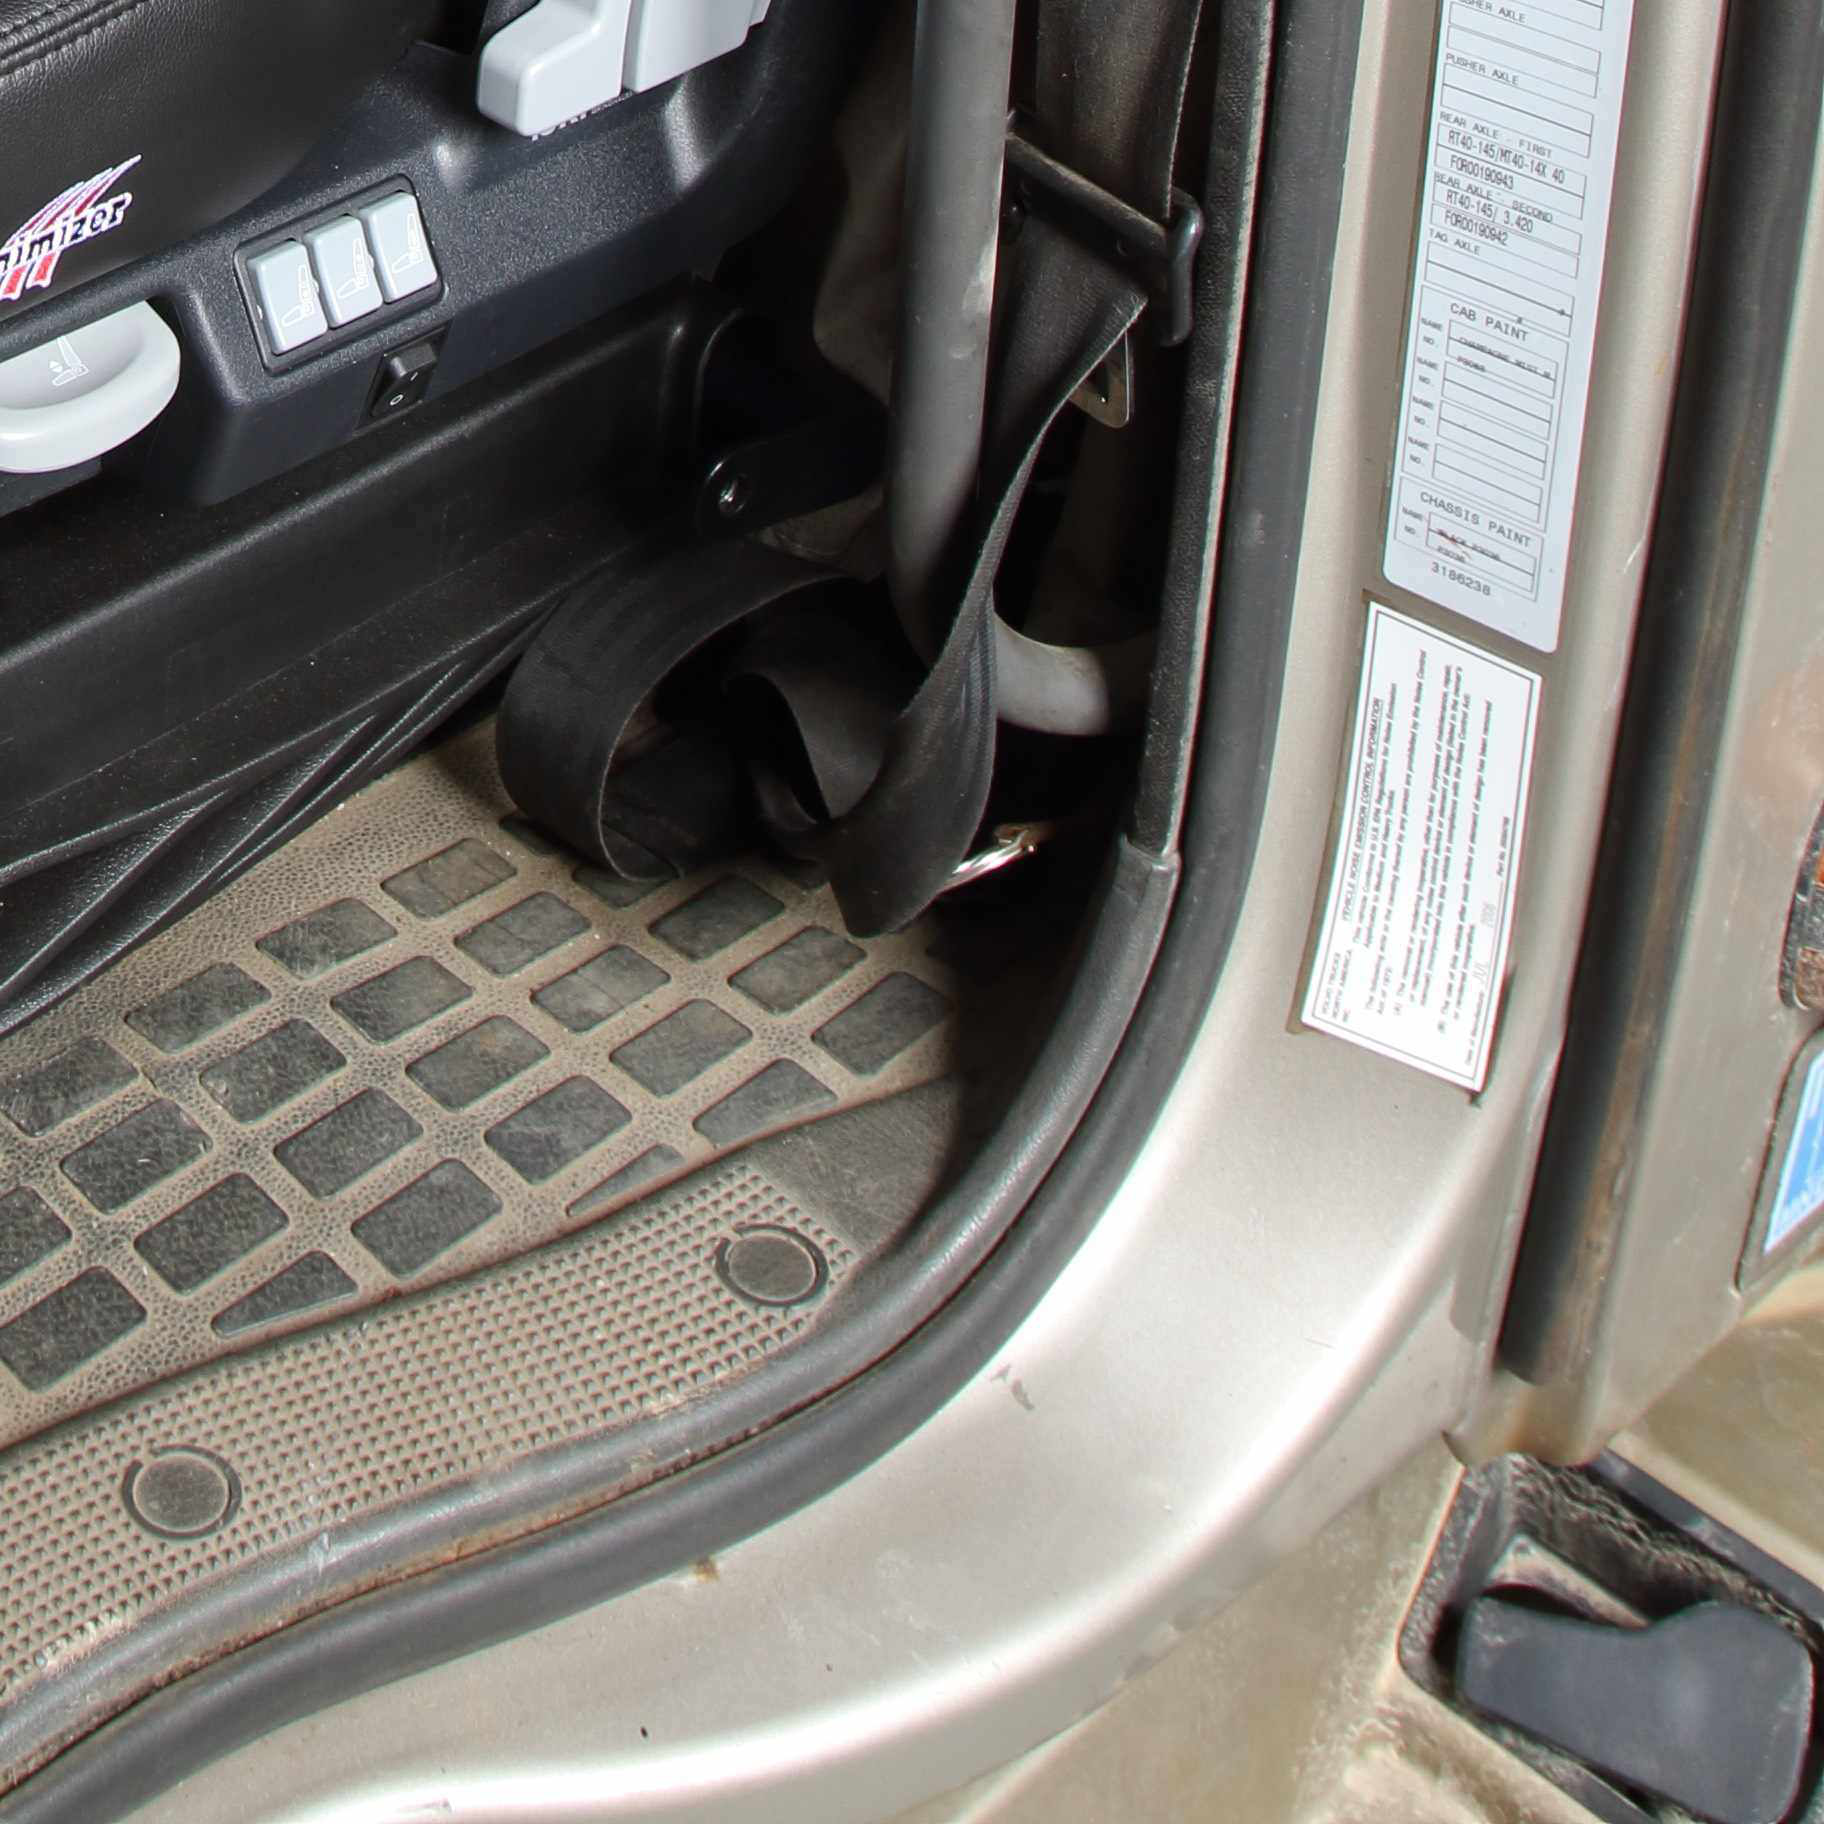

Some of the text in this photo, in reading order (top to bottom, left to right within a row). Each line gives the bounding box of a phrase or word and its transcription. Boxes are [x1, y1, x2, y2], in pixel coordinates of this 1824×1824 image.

[1498, 6, 1524, 23] AXLE
[1445, 52, 1518, 85] PUSHER AXLE
[1439, 110, 1551, 158] REAR AXLE FIRST
[1551, 165, 1565, 185] 40
[1502, 208, 1534, 234] 3.420
[1453, 238, 1480, 255] AXLE
[1449, 302, 1528, 341] CAB PAINT
[1419, 491, 1479, 525] CHASSIS
[1487, 520, 1531, 547] PAINT
[1431, 561, 1491, 596] 3186238
[1362, 761, 1375, 802] CONTROL
